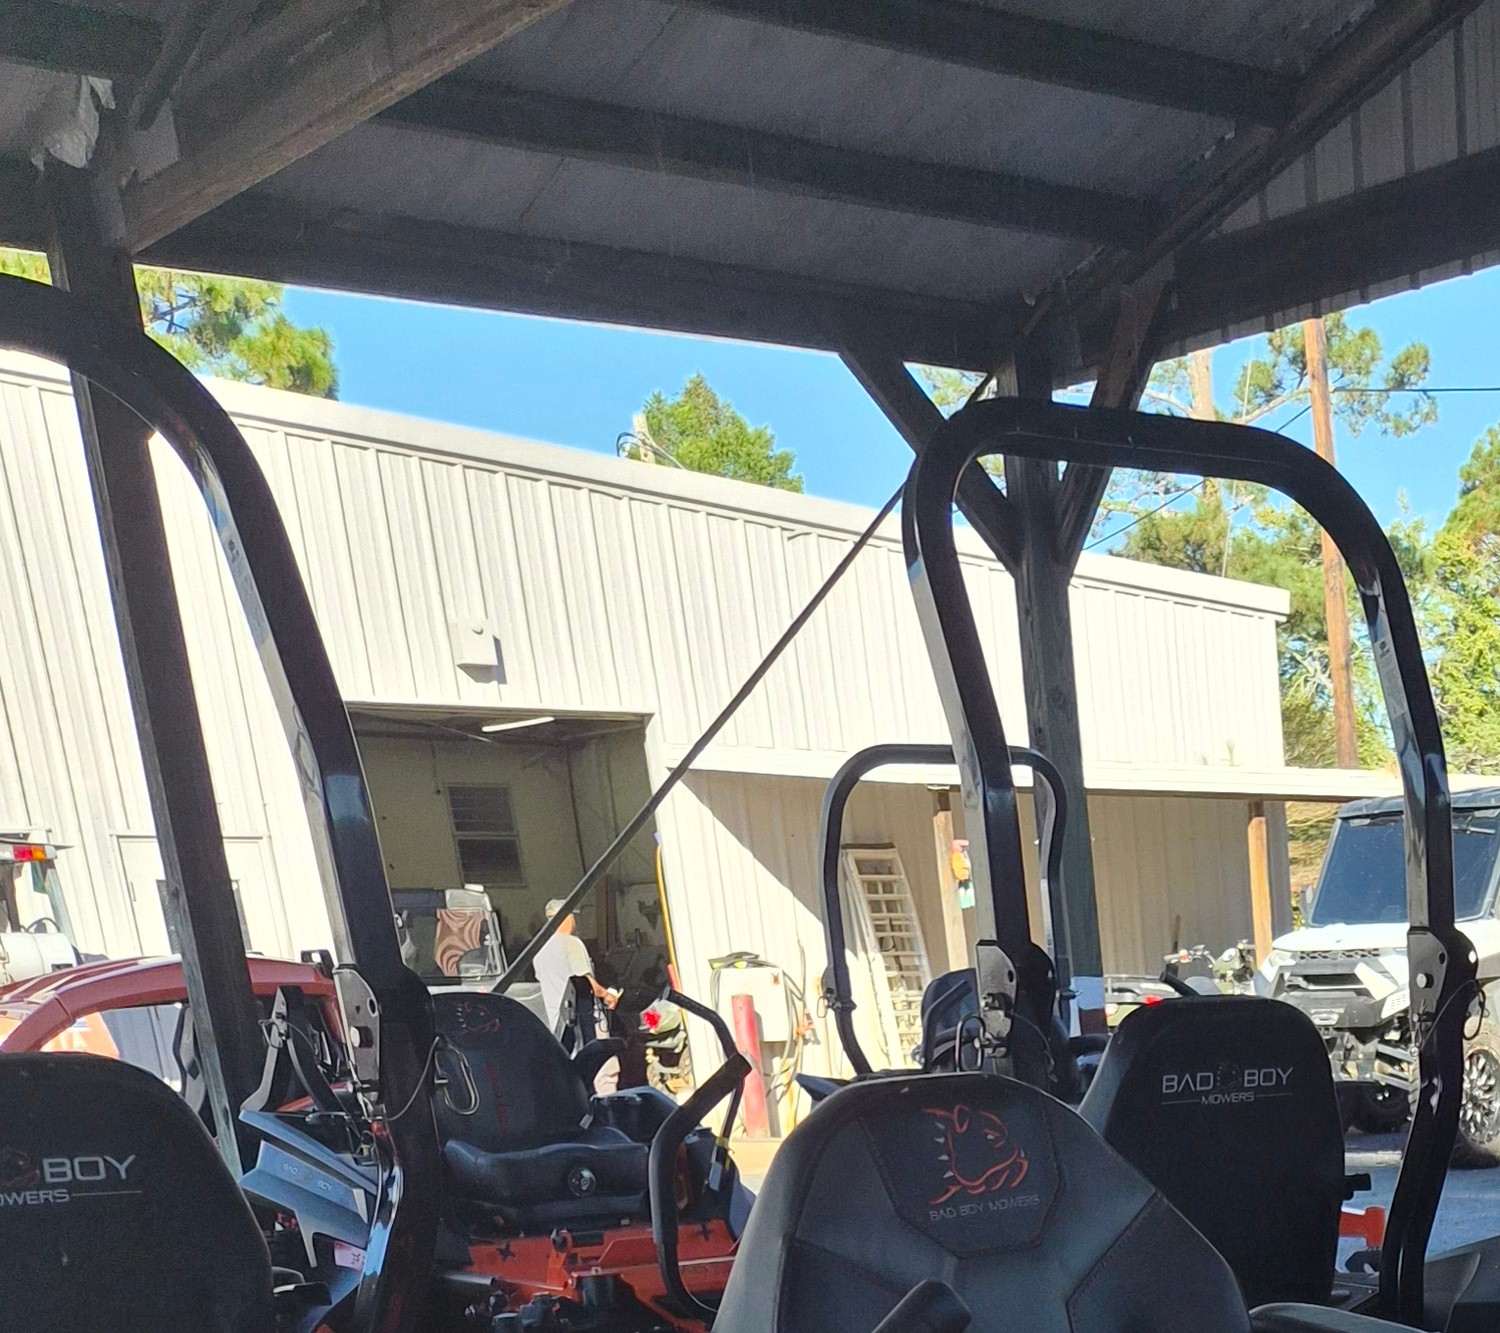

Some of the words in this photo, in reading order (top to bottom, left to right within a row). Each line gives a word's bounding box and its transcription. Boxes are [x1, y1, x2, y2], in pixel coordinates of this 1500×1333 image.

[1162, 1072, 1214, 1094] BAD
[1243, 1067, 1293, 1088] BOY
[1201, 1091, 1255, 1105] MOWERS
[42, 1154, 136, 1182] BOY
[929, 1208, 958, 1221] BAD
[959, 1203, 984, 1216] BOY
